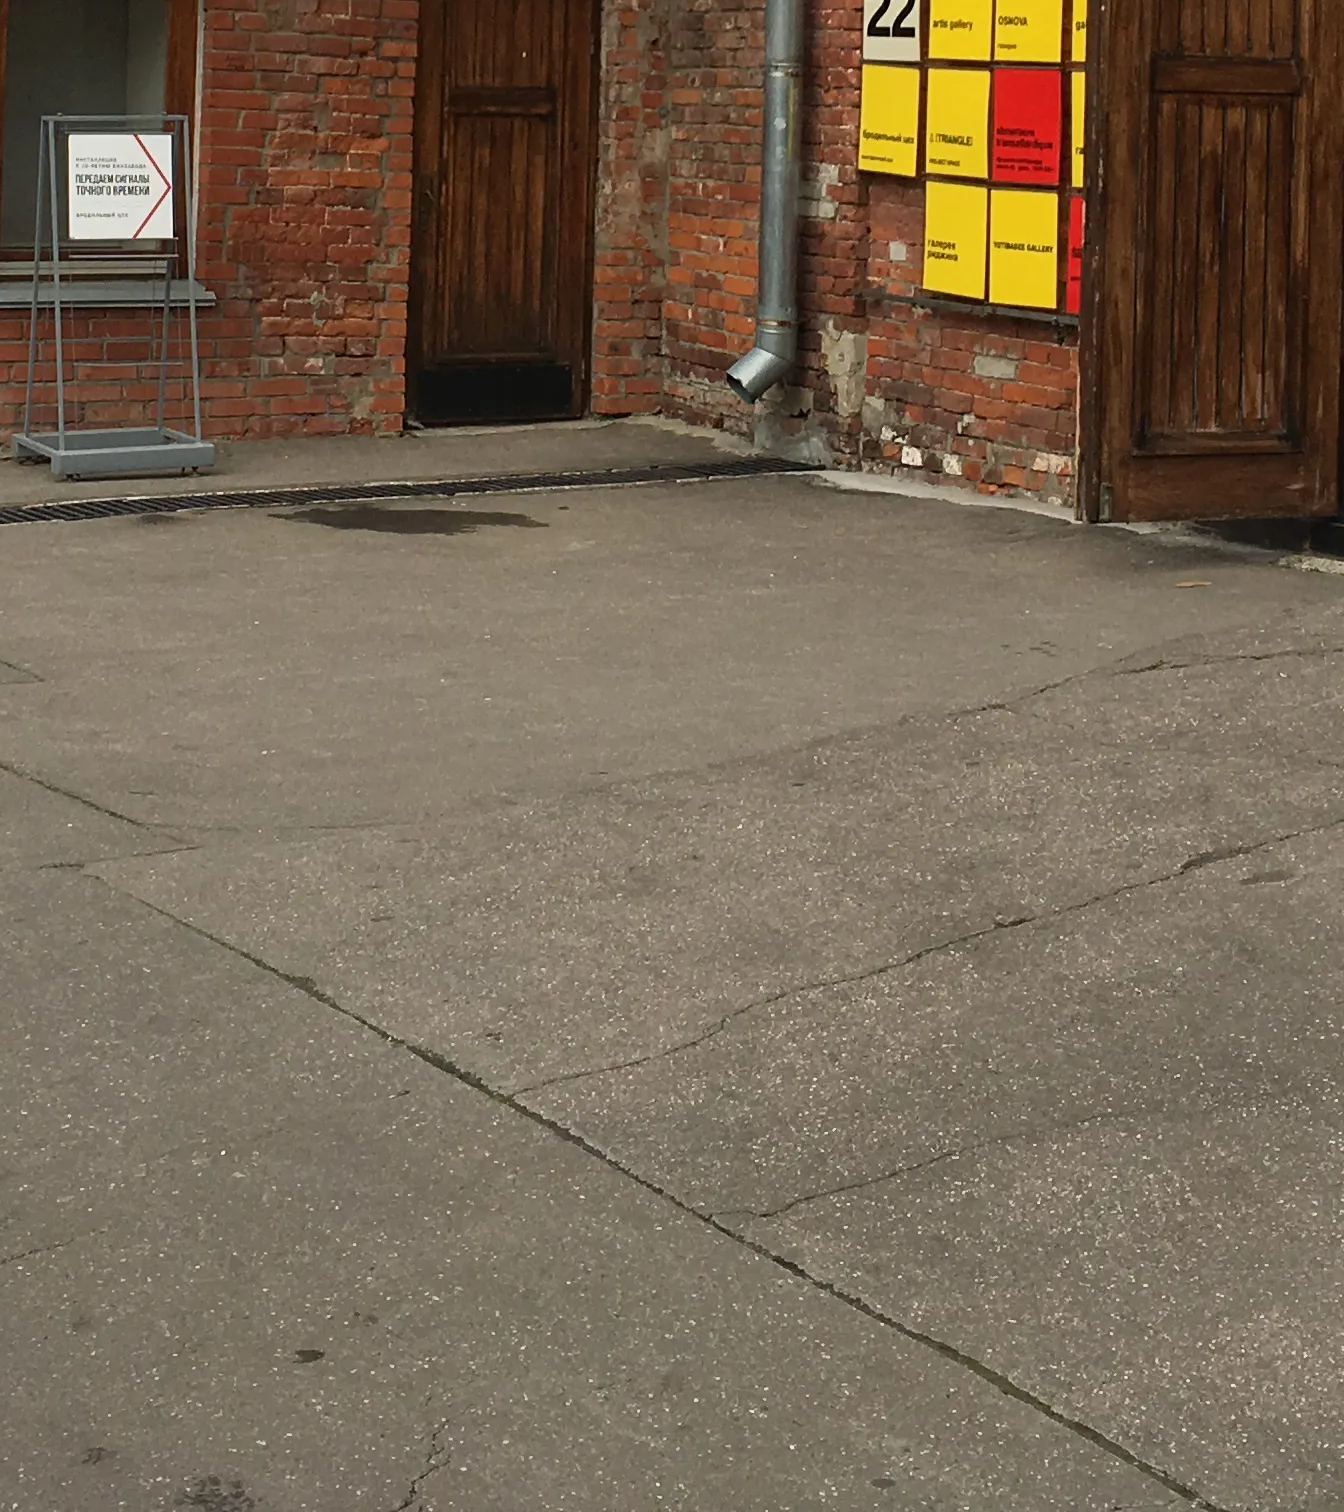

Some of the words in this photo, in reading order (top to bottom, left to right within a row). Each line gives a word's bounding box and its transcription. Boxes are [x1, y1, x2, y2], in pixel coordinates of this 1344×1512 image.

[949, 17, 974, 32] gallery
[75, 174, 114, 185] ПЕРЕДАЕМ
[115, 174, 150, 184] СИГНАЛЫ
[76, 185, 112, 196] ТОЧНОГО
[113, 185, 150, 196] ВРЕМЕНИ
